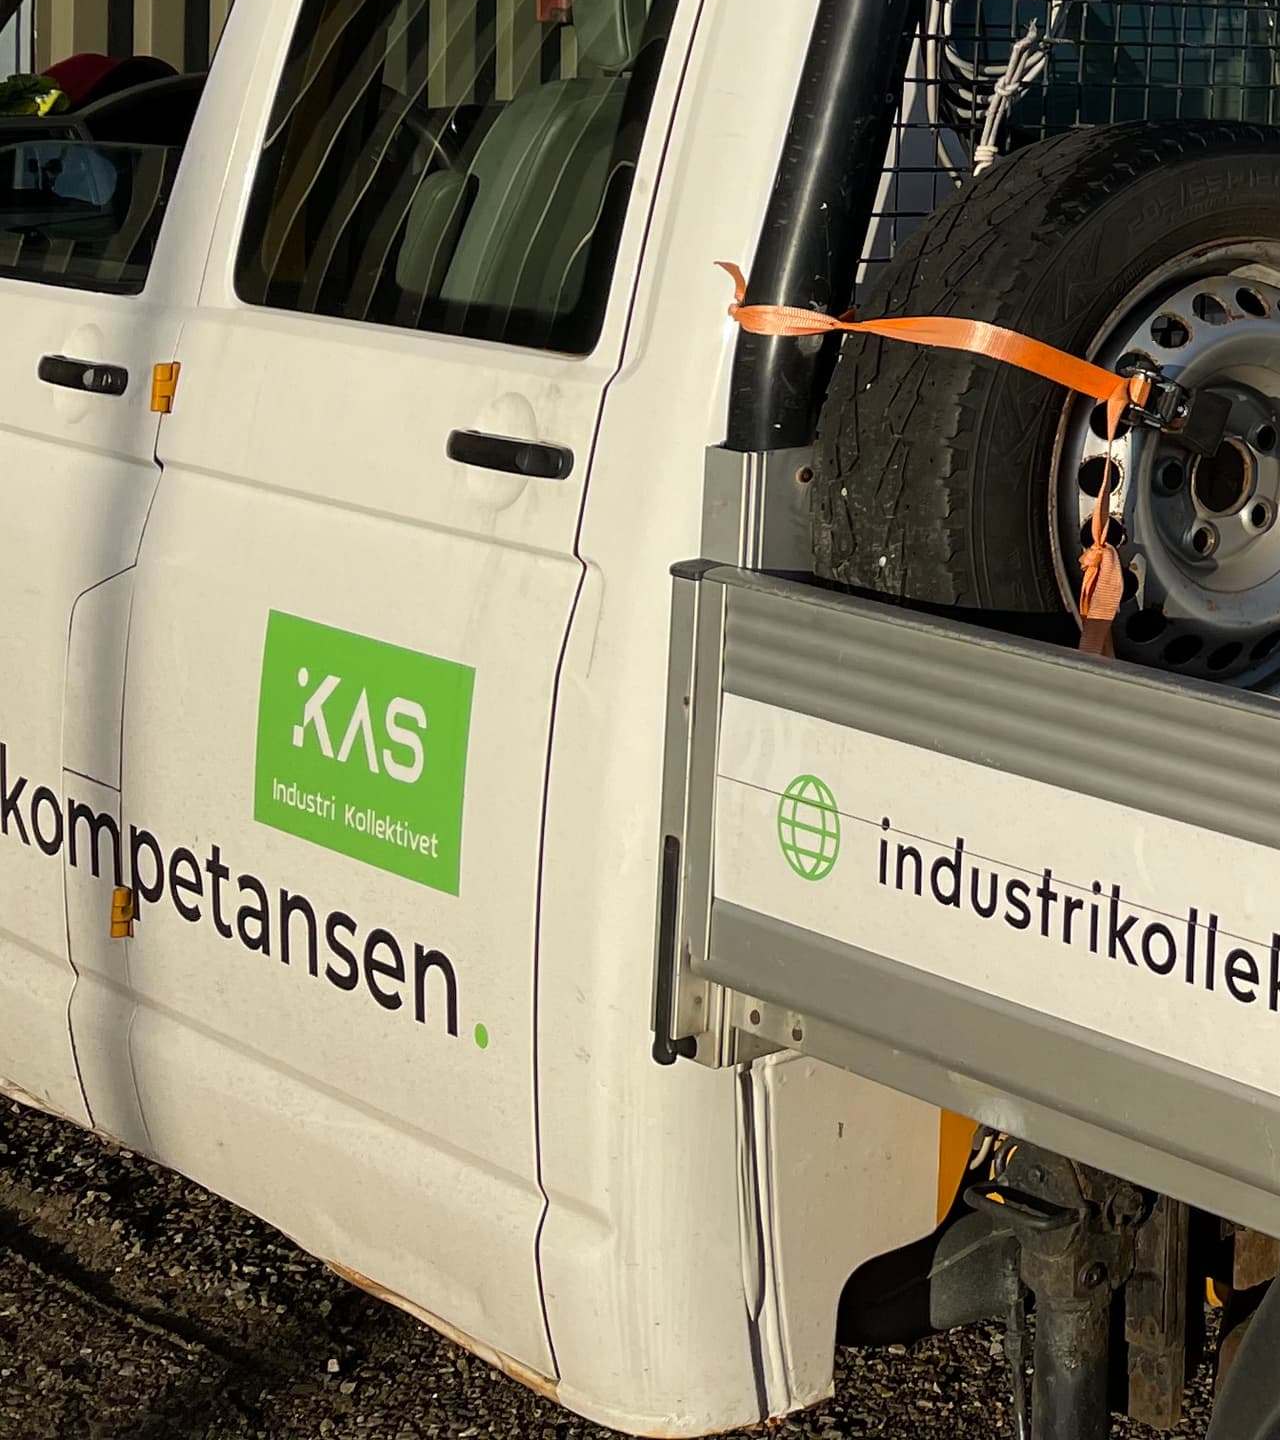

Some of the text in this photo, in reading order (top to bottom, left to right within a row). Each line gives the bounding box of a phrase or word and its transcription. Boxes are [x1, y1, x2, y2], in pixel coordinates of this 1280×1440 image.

[292, 666, 428, 785] KAS
[272, 776, 439, 859] Industri Kollektivet
